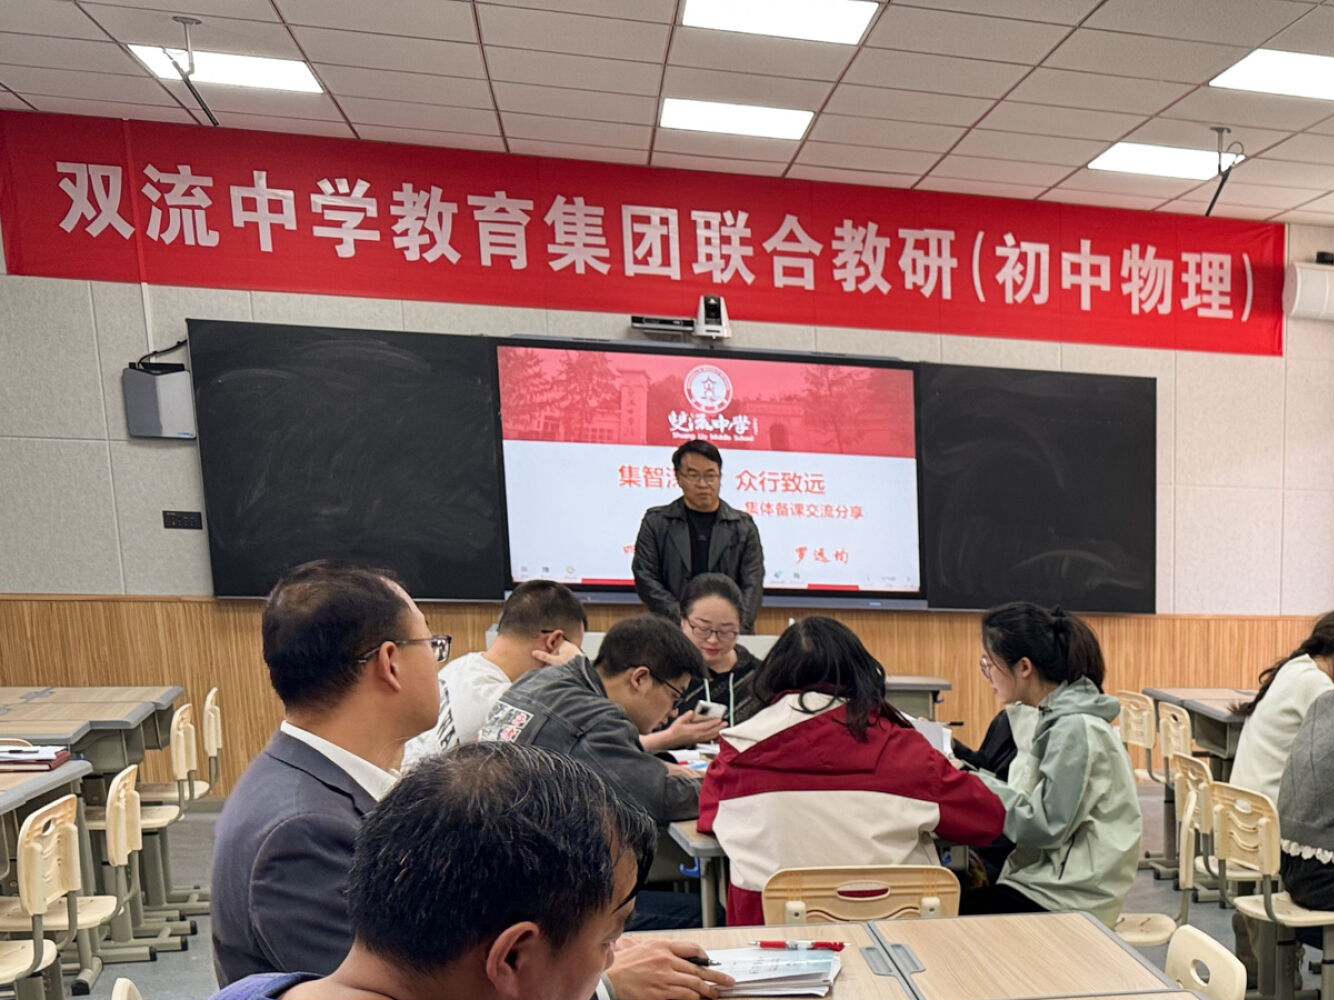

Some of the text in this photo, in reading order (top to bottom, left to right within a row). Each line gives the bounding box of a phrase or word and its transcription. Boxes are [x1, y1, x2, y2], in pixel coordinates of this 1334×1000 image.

[55, 160, 1255, 323] 双流中学教育集团联合教研(初中物理)
[735, 469, 826, 495] 众行致远
[745, 501, 864, 519] 集体备课交流分享
